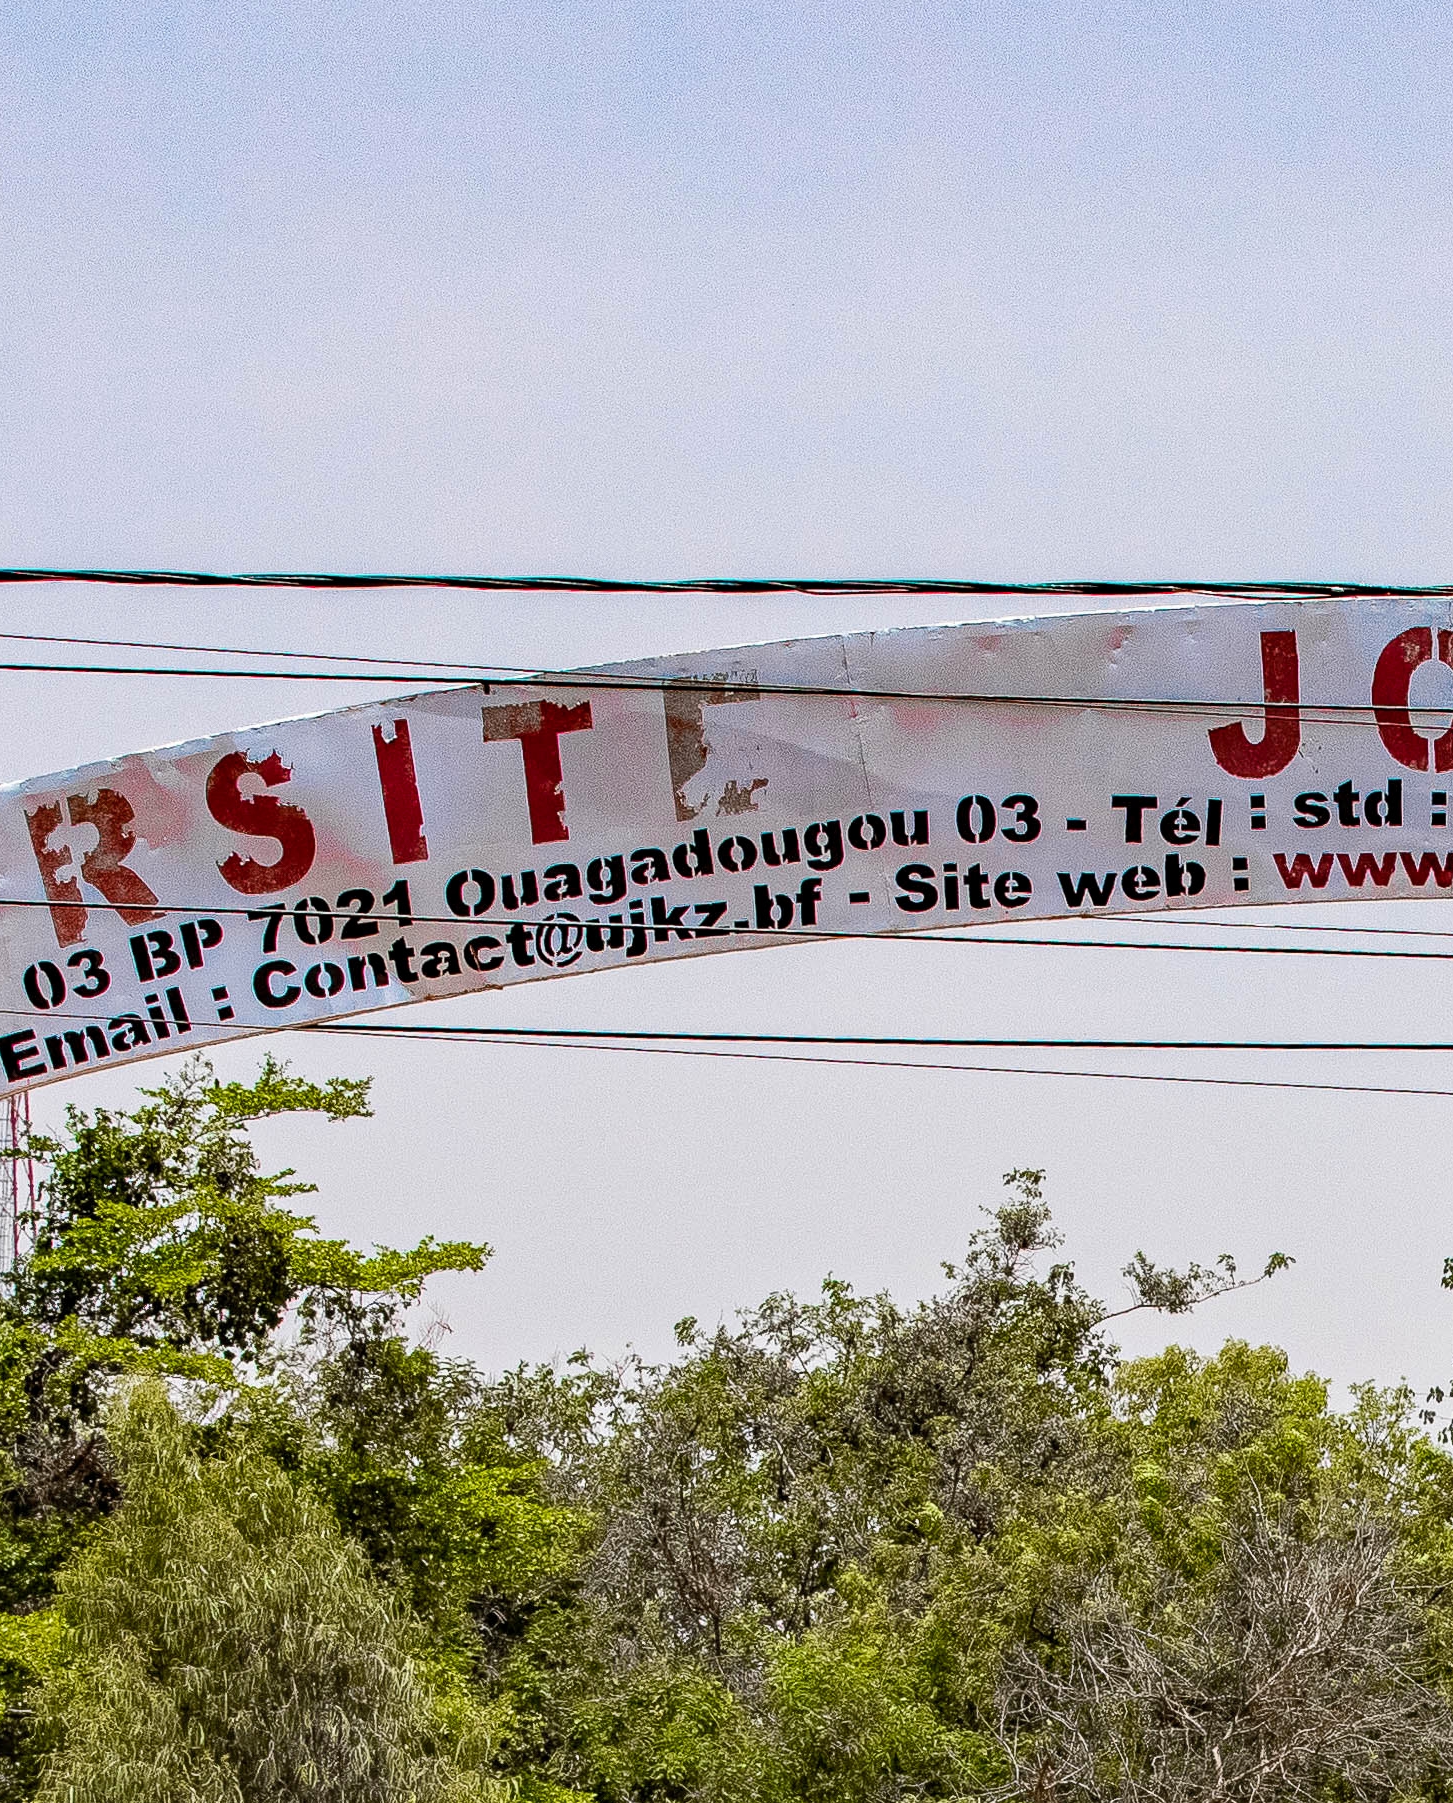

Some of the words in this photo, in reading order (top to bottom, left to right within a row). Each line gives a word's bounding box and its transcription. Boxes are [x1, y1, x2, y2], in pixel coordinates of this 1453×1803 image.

[24, 948, 111, 1011] 03
[130, 918, 224, 983] BP
[248, 879, 412, 954] 7021
[445, 809, 930, 917] Ouagadougou
[956, 795, 1042, 845] 03
[1112, 796, 1222, 847] Tél
[1293, 777, 1403, 829] std
[252, 876, 824, 1010] Contact@ujkz.bf
[893, 860, 1033, 913] Site
[1057, 851, 1206, 902] web
